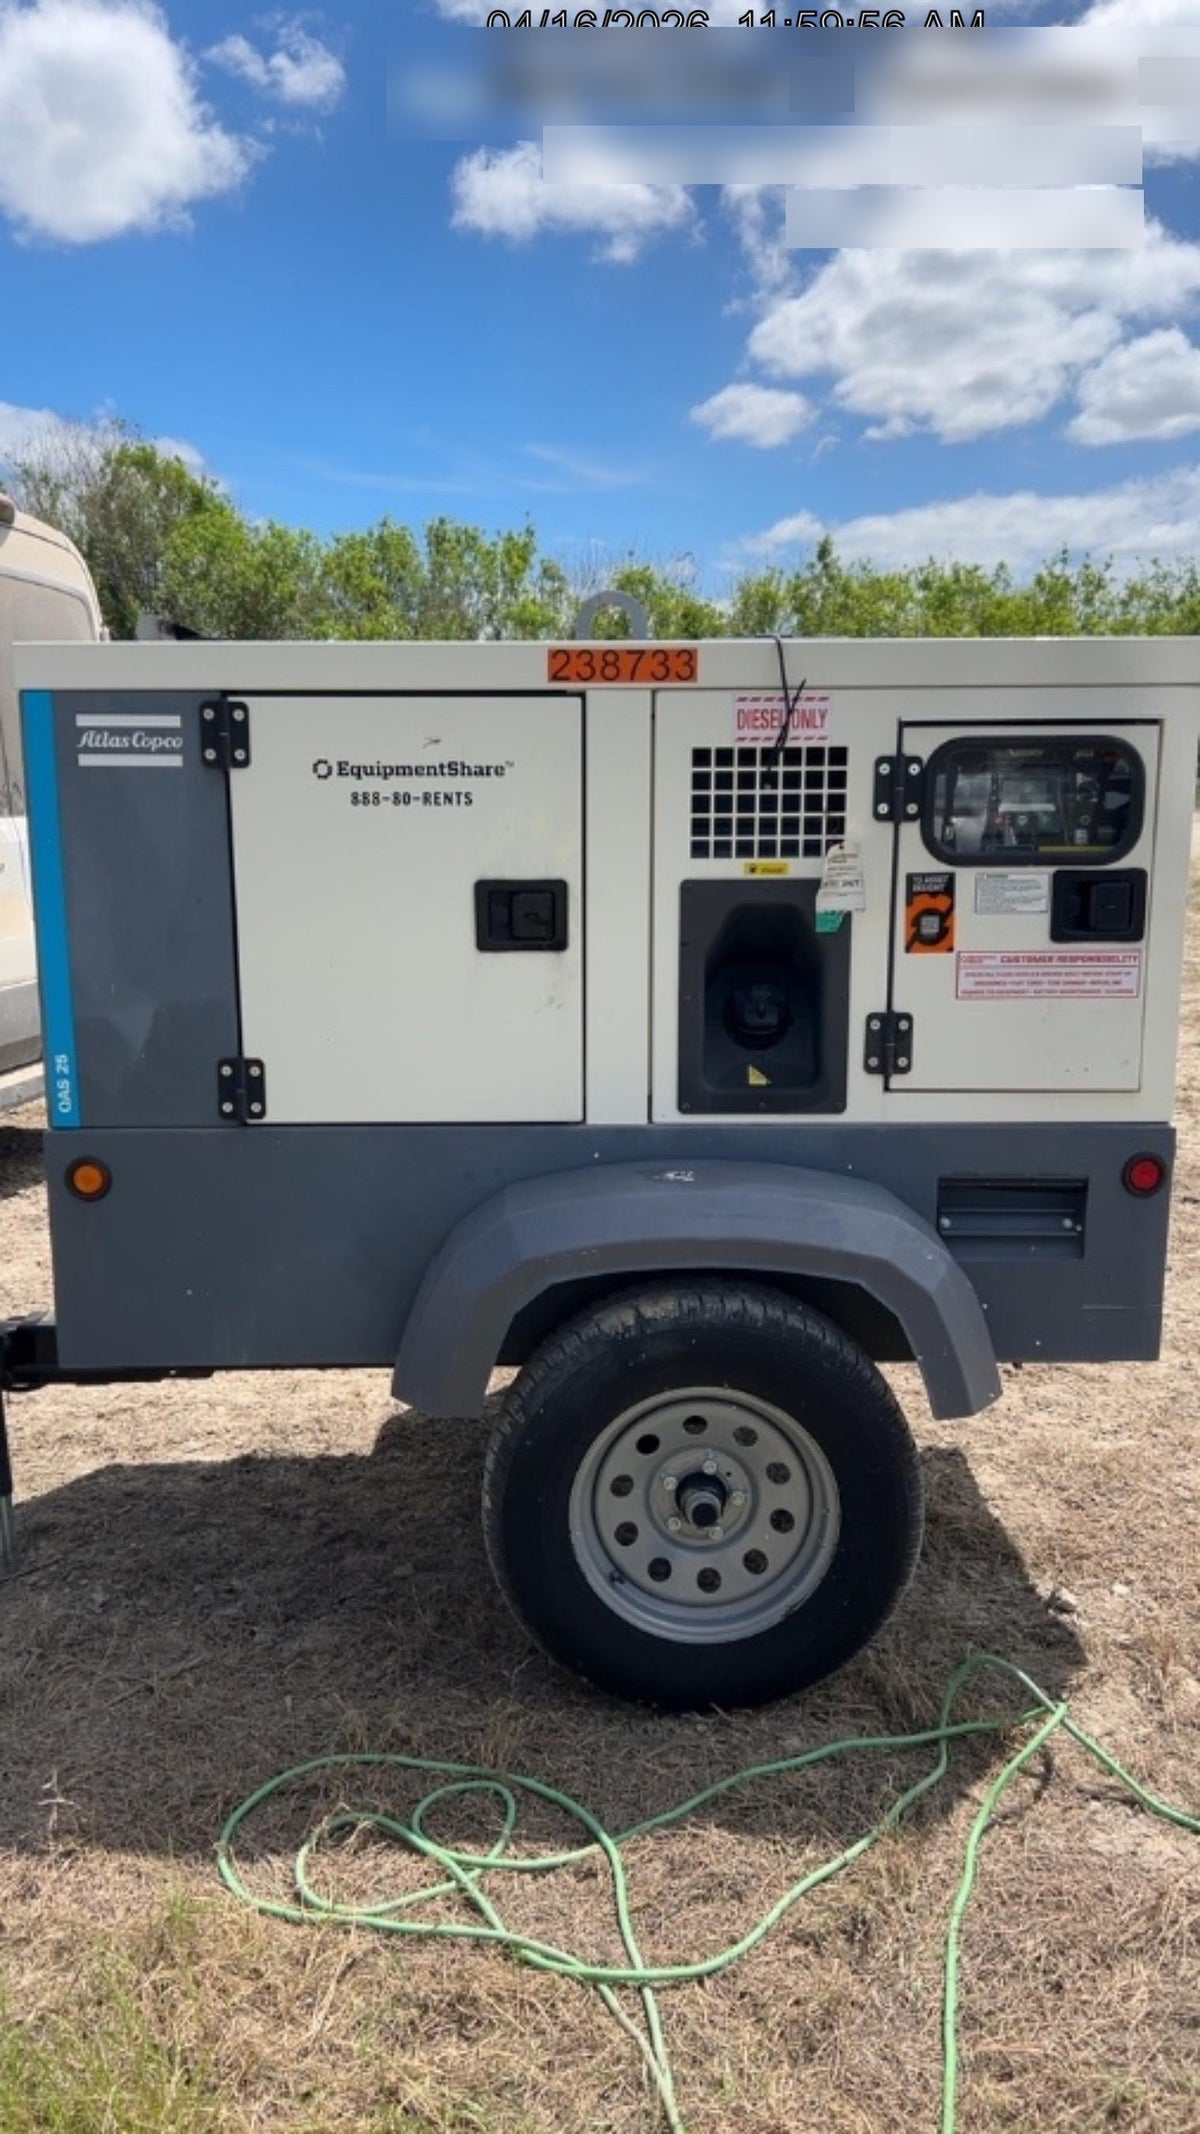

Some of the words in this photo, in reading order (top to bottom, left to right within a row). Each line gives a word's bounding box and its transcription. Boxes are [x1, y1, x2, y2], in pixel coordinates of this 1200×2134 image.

[551, 649, 694, 682] 238733
[736, 708, 786, 730] DIESEL
[791, 707, 828, 730] ONLY
[77, 729, 129, 748] Atlas
[132, 729, 184, 752] Copco
[350, 791, 474, 807] 888-80-RENTS
